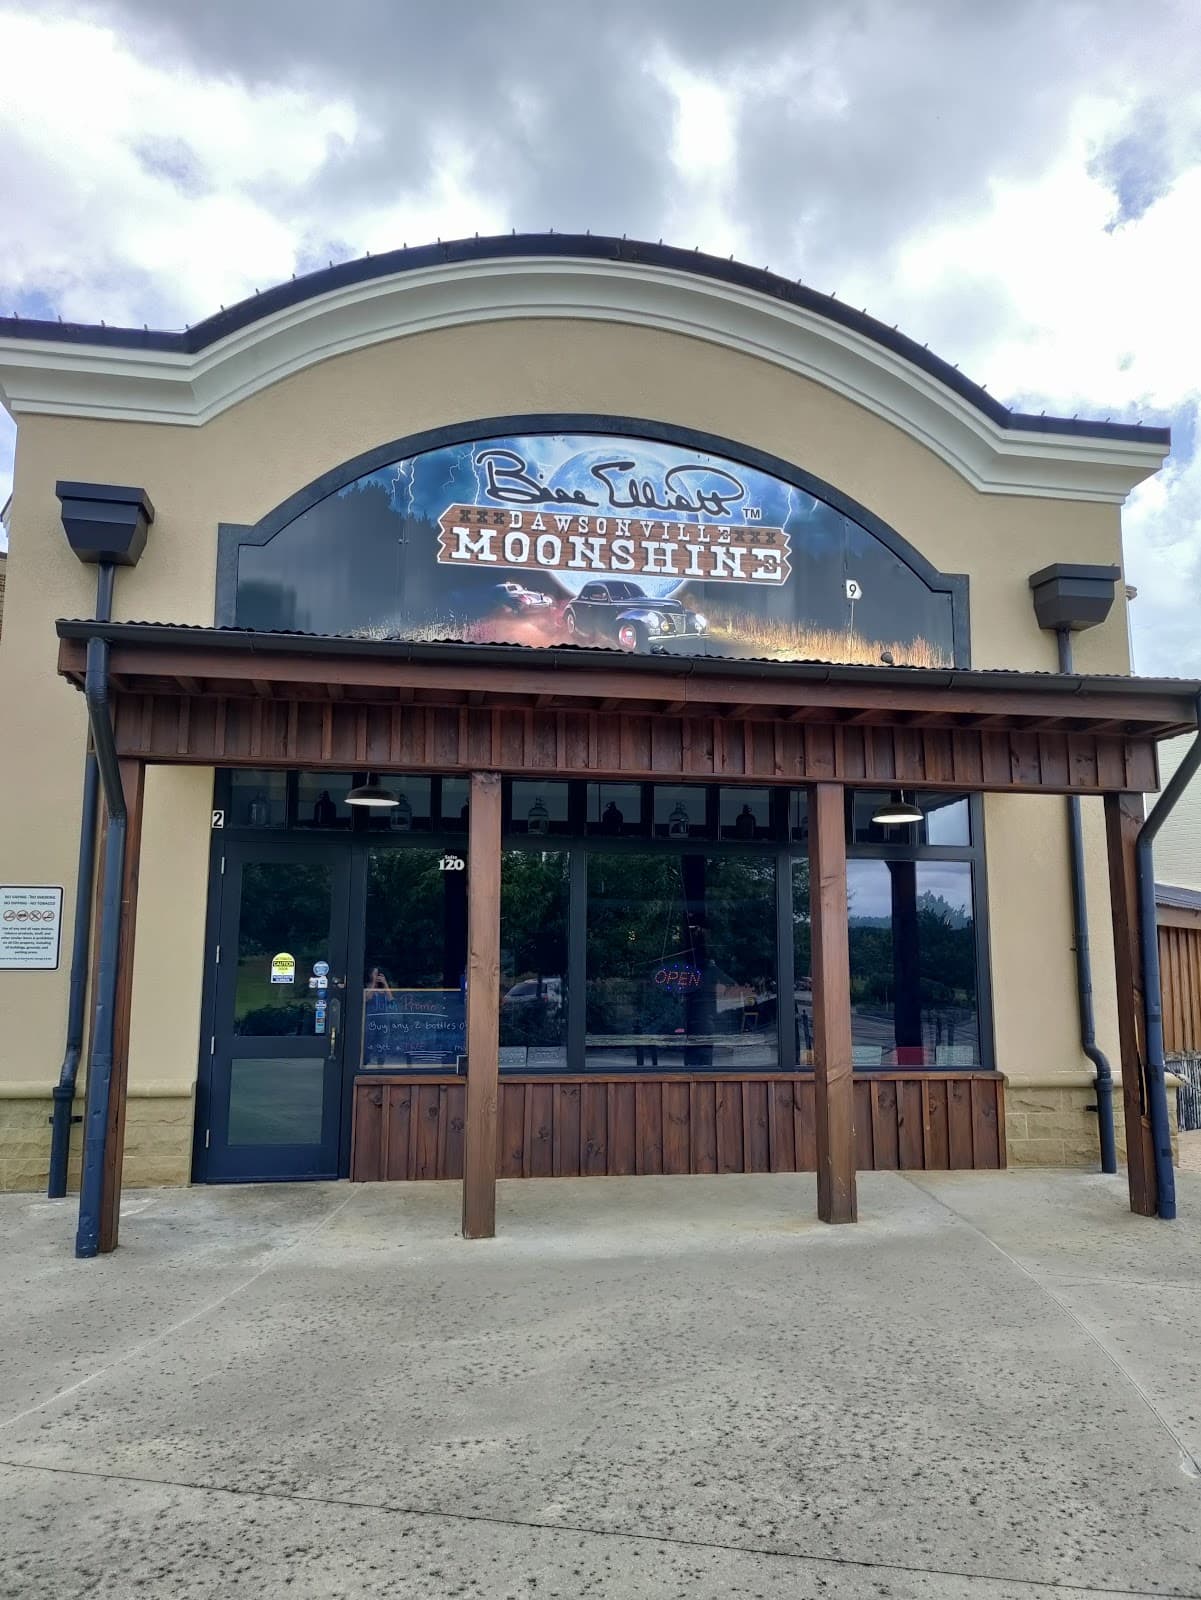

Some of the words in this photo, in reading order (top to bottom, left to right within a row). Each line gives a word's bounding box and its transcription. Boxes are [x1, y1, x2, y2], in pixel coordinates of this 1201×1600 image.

[509, 511, 732, 543] DAWSONVILLE
[451, 526, 783, 580] MOONSHINE
[849, 583, 857, 597] 9
[213, 811, 222, 827] 2
[438, 859, 465, 872] 120
[655, 970, 701, 986] OPEN
[368, 1021, 388, 1033] Buy
[392, 1023, 409, 1033] any
[425, 1021, 456, 1031] bottles
